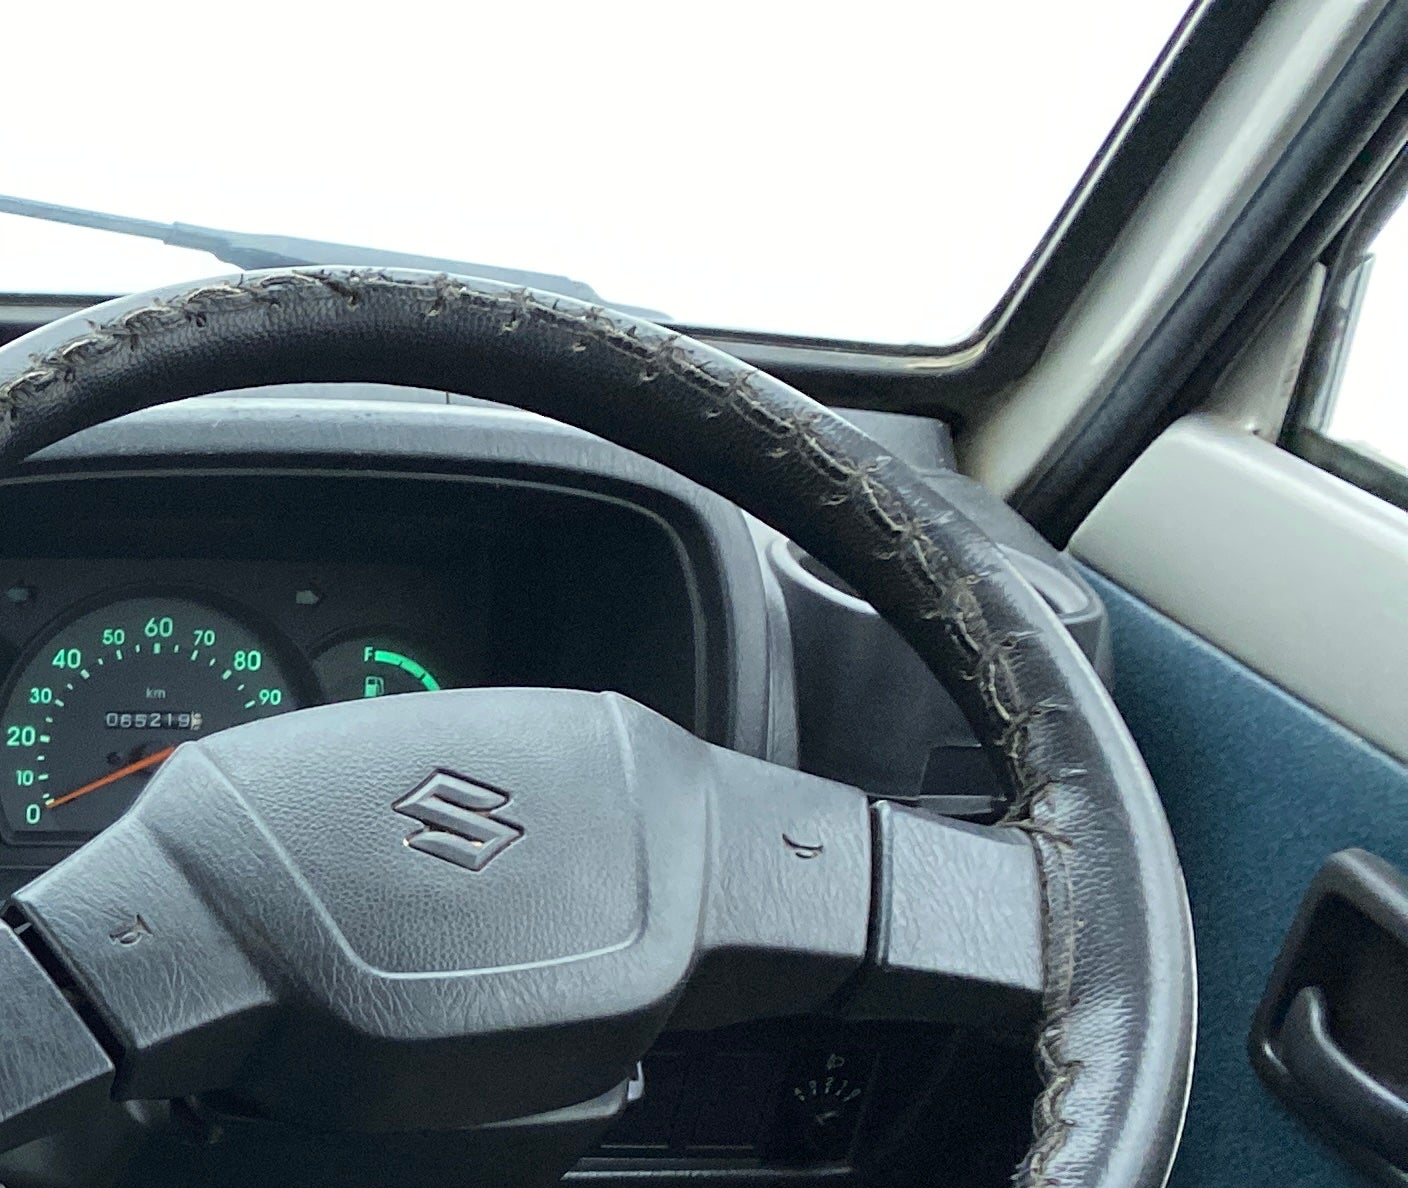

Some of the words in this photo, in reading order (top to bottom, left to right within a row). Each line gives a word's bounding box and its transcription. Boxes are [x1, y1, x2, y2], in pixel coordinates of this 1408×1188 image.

[144, 617, 174, 637] 60
[102, 629, 126, 645] 50
[193, 630, 216, 646] 70
[52, 649, 82, 669] 40
[234, 650, 262, 671] 80
[363, 646, 374, 662] F
[29, 688, 53, 704] 30
[146, 686, 166, 699] km
[258, 689, 283, 705] 90
[6, 726, 36, 747] 20
[16, 769, 34, 786] 10
[25, 803, 41, 824] 0
